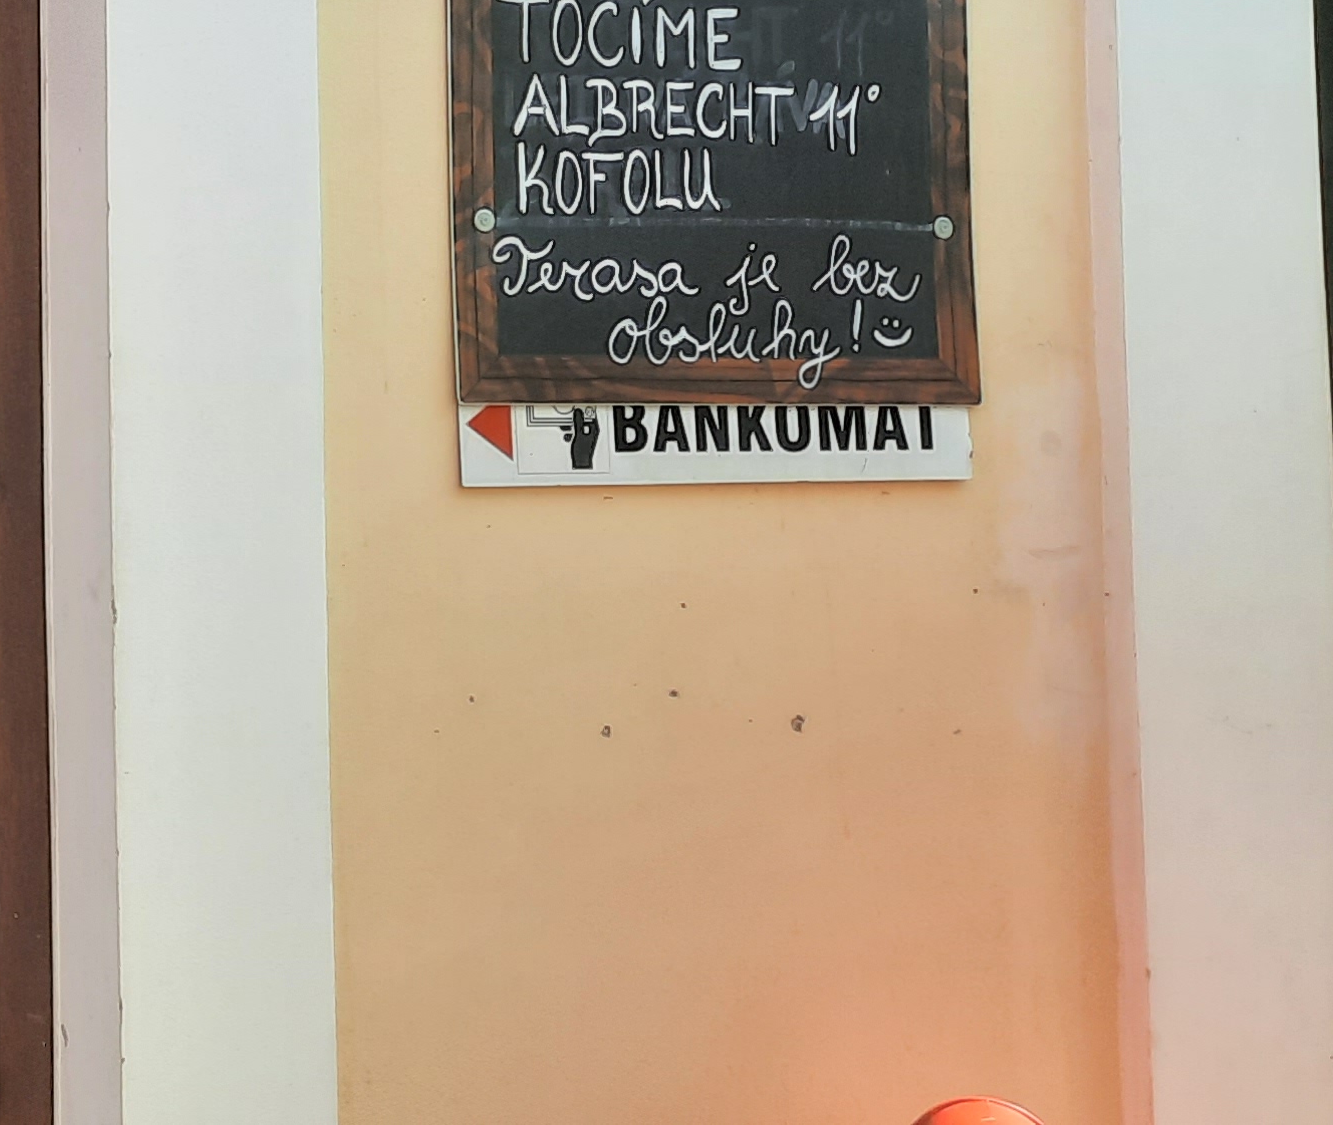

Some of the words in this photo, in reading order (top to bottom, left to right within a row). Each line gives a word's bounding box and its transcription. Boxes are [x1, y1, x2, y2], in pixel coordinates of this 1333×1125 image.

[513, 75, 794, 147] ALBRECHT
[517, 141, 723, 216] KOFOLU
[491, 235, 699, 300] Terasa
[726, 243, 779, 315] je
[812, 235, 921, 302] bez
